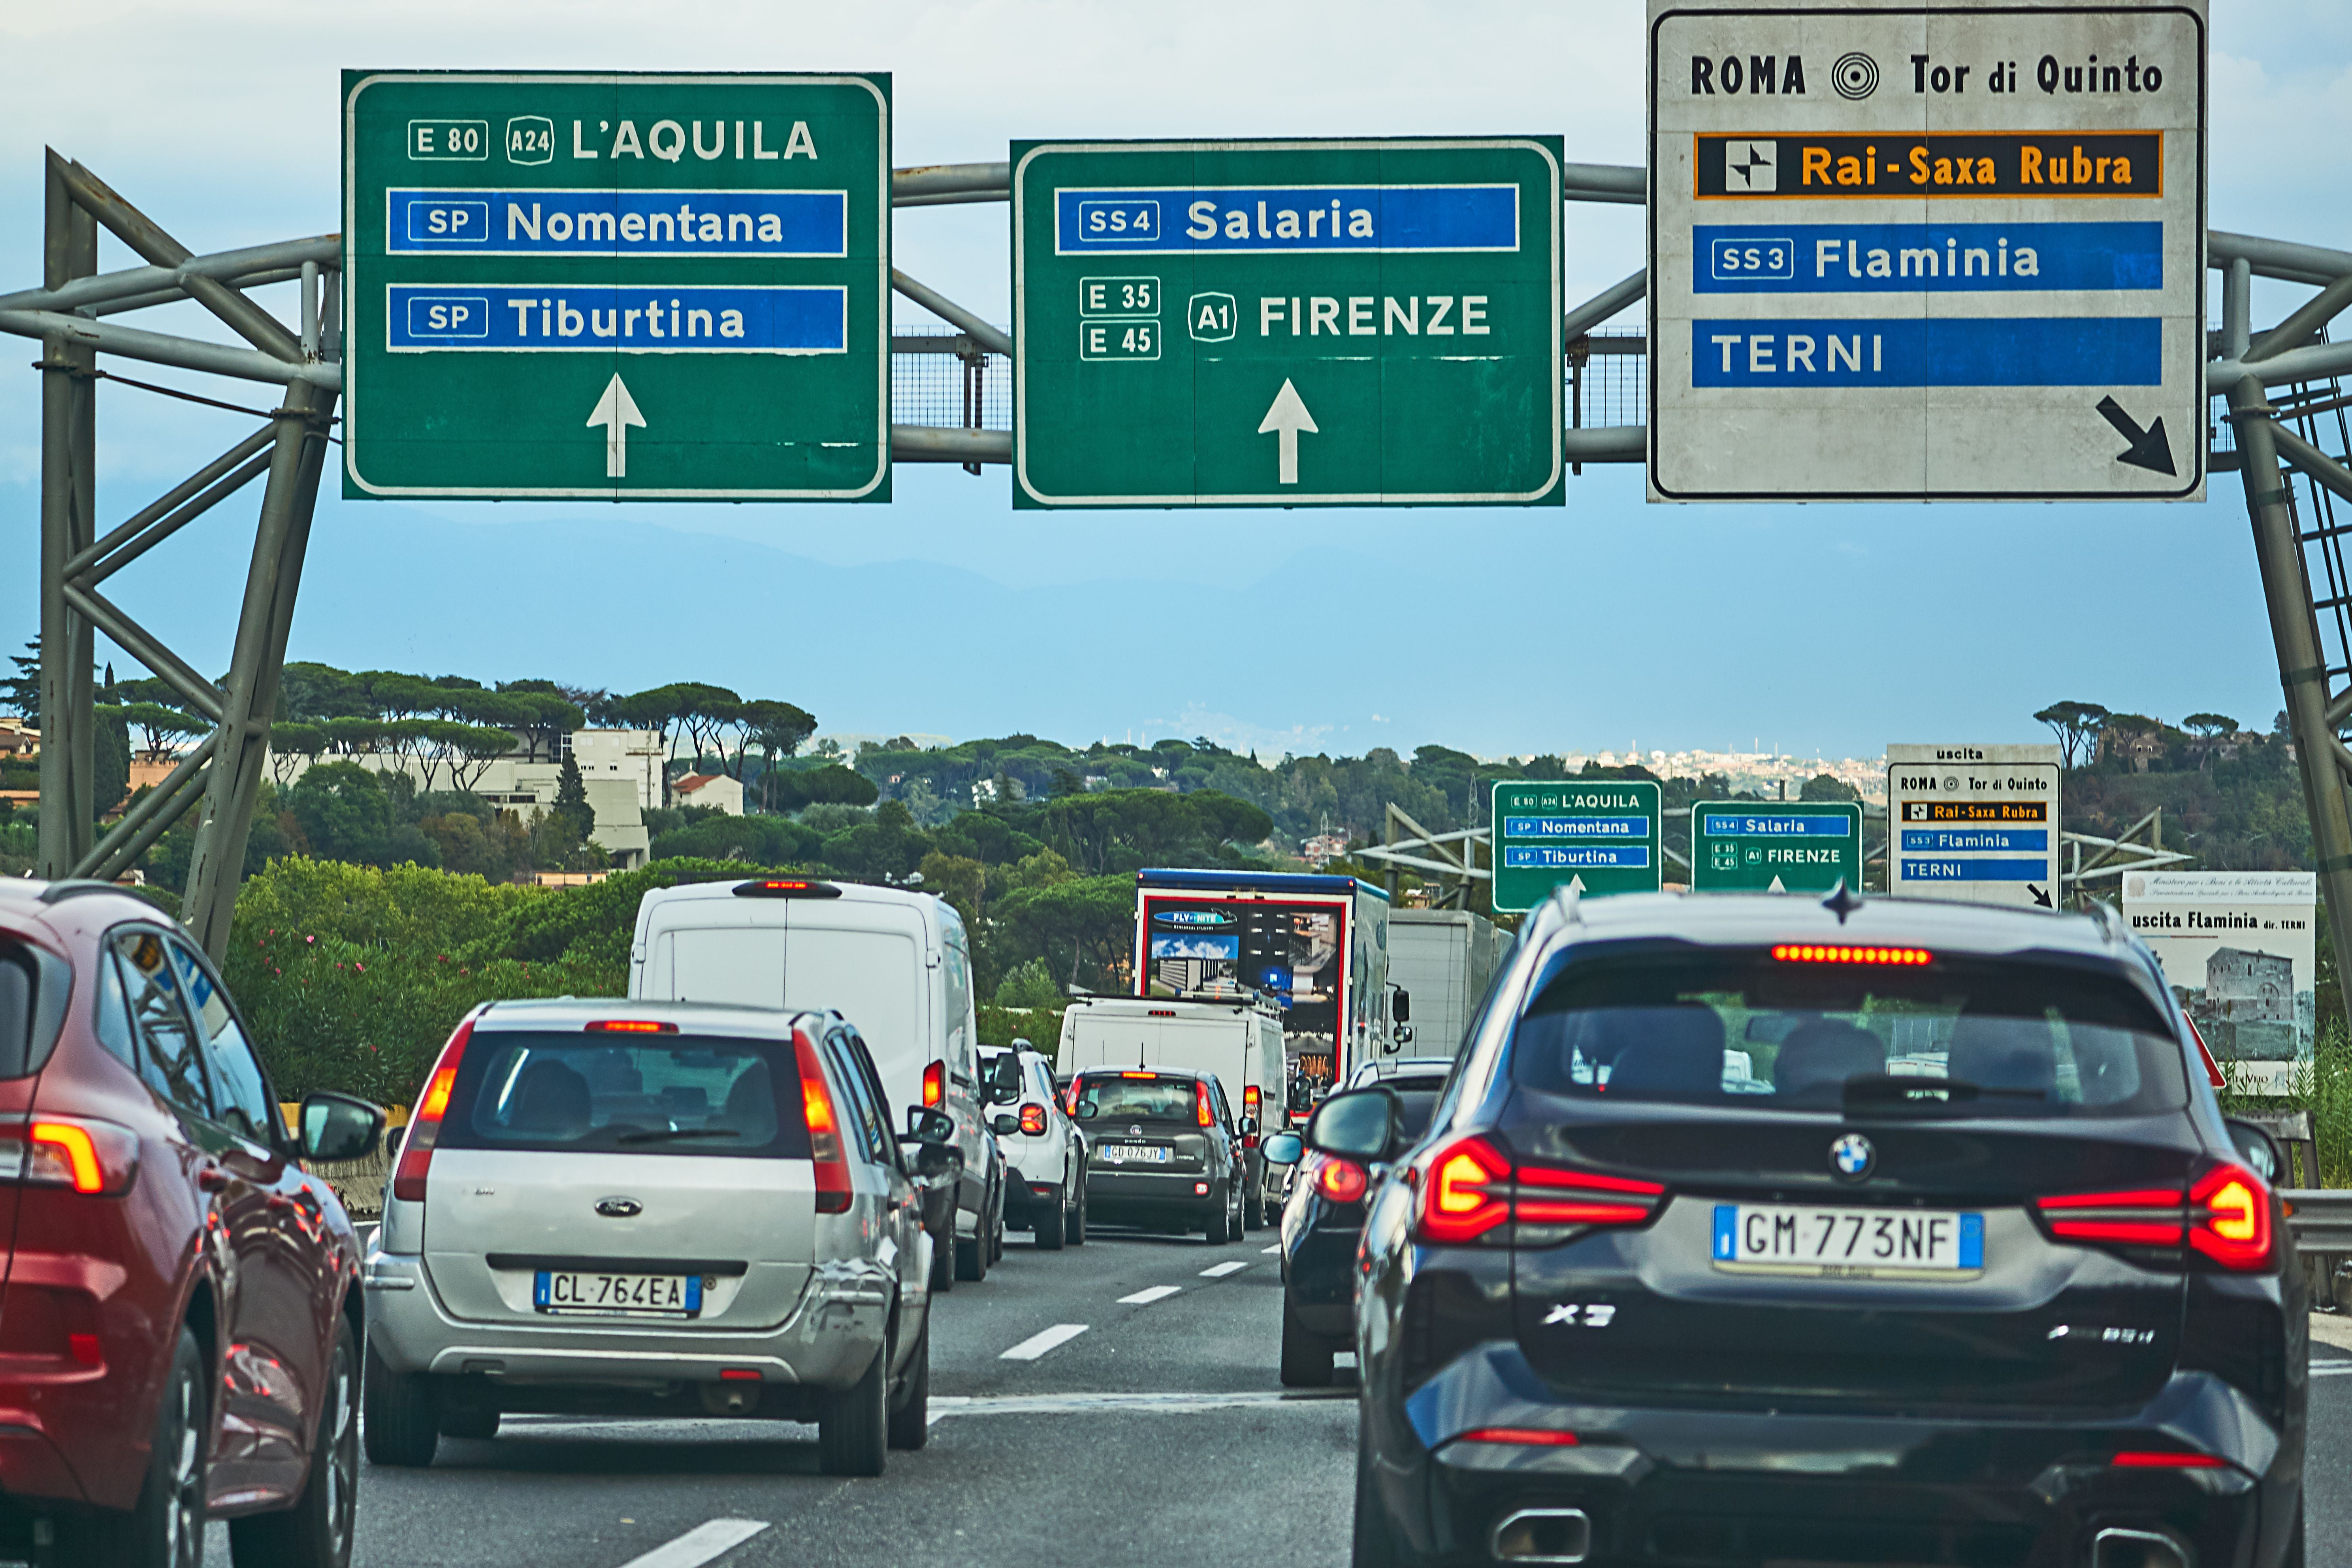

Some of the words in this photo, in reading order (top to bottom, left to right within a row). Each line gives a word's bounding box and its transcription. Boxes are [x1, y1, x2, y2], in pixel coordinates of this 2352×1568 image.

[1692, 55, 1806, 95] ROMA
[1911, 54, 1970, 93] Tor
[1989, 61, 2016, 93] di
[2037, 54, 2162, 96] Quinto
[418, 128, 434, 152] E
[448, 128, 478, 152] 80
[511, 130, 549, 152] A24
[574, 120, 817, 163] L'AQUILA
[2021, 146, 2132, 184] Rubra
[428, 209, 469, 233] SP
[507, 203, 783, 242] Nomentana
[1089, 210, 1127, 232] SS
[1133, 210, 1150, 231] 4
[1186, 199, 1374, 240] Salaria
[1722, 248, 1760, 270] SS
[1768, 248, 1783, 269] 3
[1816, 237, 2039, 278] Flaminia
[1090, 284, 1106, 309] E
[1122, 284, 1150, 309] 35
[428, 305, 469, 329] SP
[508, 298, 745, 338] Tiburtina
[1198, 305, 1228, 329] A1
[1260, 296, 1490, 336] FIRENZE
[1090, 328, 1107, 352] E
[1121, 328, 1151, 352] 45
[1712, 335, 1881, 372] TERNI
[1937, 747, 1983, 760] uscita
[1901, 777, 1937, 790] ROMA
[1968, 777, 1987, 790] Tor
[1993, 779, 2002, 790] di
[2007, 777, 2047, 791] Quinto
[1523, 797, 1534, 806] 80
[1563, 794, 1639, 808] L'AQUILA
[2002, 806, 2038, 818] Rubra
[1518, 823, 1531, 831] SP
[1542, 821, 1629, 833] Nomentana
[1746, 819, 1804, 832] Salaria
[1939, 834, 2009, 847] Flaminia
[1518, 852, 1531, 861] SP
[1542, 850, 1617, 863] Tiburtina
[1749, 851, 1759, 860] A1
[1768, 849, 1840, 863] FIRENZE
[1908, 864, 1961, 876] TERNI
[1173, 913, 1190, 922] FLY
[1197, 914, 1216, 923] NITE
[2132, 911, 2181, 928] uscita
[2188, 911, 2258, 928] Flaminia
[2263, 920, 2278, 929] dir.
[2281, 920, 2305, 930] TERNI
[1544, 1304, 1616, 1327] X3
